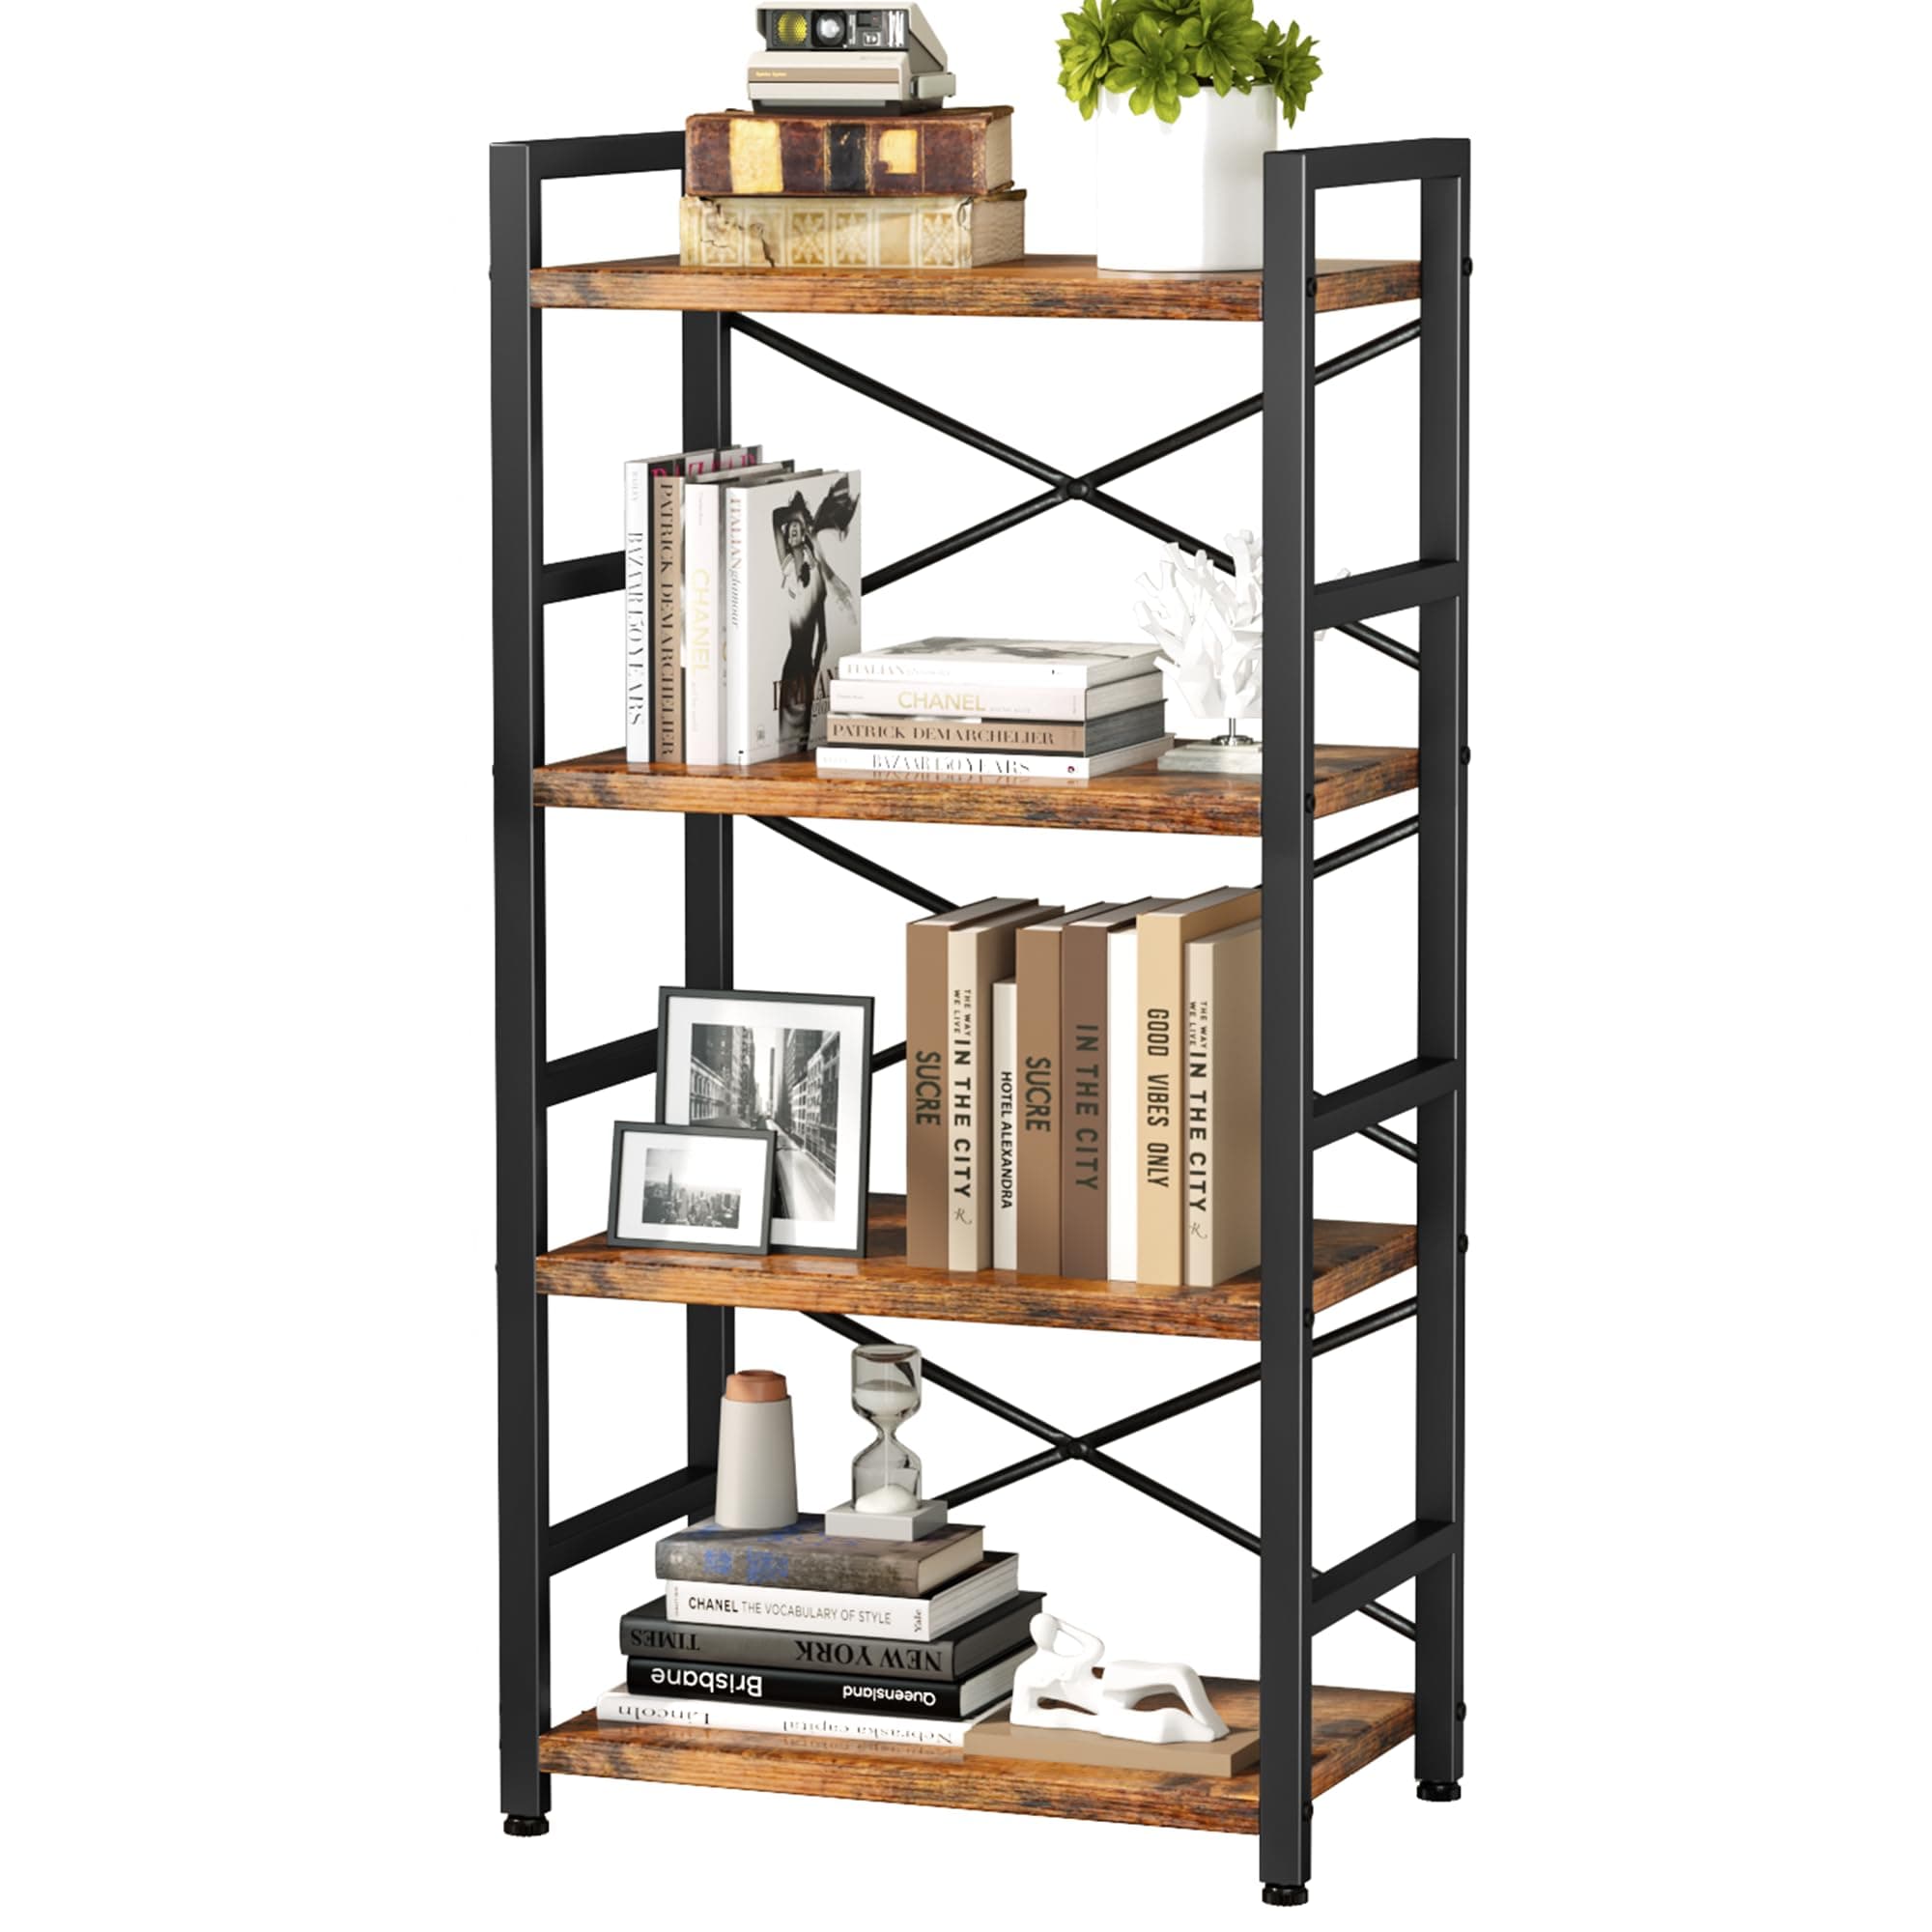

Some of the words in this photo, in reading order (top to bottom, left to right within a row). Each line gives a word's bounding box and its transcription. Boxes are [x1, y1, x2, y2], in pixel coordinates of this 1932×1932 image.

[661, 484, 672, 573] PATRICK
[692, 569, 710, 672] CHANEL
[661, 583, 674, 754] DEMARCHELIER
[897, 692, 986, 712] CHANEL
[833, 724, 906, 740] PATRICK
[913, 727, 1054, 746] DEMARCHELIER
[954, 989, 960, 1005] WE
[1189, 1001, 1196, 1018] WE
[1076, 1025, 1098, 1051] IN
[1148, 1009, 1169, 1056] GOOD
[954, 1039, 971, 1065] IN
[1189, 1052, 1207, 1077] IN
[915, 1051, 942, 1125] SUCRE
[954, 1077, 971, 1126] THE
[1001, 1071, 1012, 1118] HOTEL
[1025, 1057, 1051, 1132] SUCRE
[1075, 1065, 1099, 1116] THE
[1147, 1074, 1169, 1126] VIBES
[1189, 1091, 1207, 1140] THE
[954, 1139, 971, 1198] CITY
[1001, 1122, 1012, 1208] ALEXANDRA
[1075, 1128, 1098, 1190] CITY
[1148, 1143, 1169, 1187] ONLY
[1189, 1152, 1207, 1211] CITY
[689, 1597, 738, 1612] CHANEL
[742, 1601, 761, 1614] THE
[765, 1604, 838, 1619] VOCABULARY
[840, 1608, 855, 1621] OF
[859, 1610, 891, 1625] STYLE
[913, 1608, 923, 1634] Yale
[631, 1629, 700, 1652] TIMES
[795, 1641, 877, 1666] YORK
[880, 1648, 943, 1672] NEW
[651, 1667, 763, 1697] Brisbane
[842, 1684, 937, 1707] Queensland
[617, 1706, 710, 1725] Lincoln
[782, 1719, 849, 1736] capital
[857, 1724, 952, 1746] Nebraska
